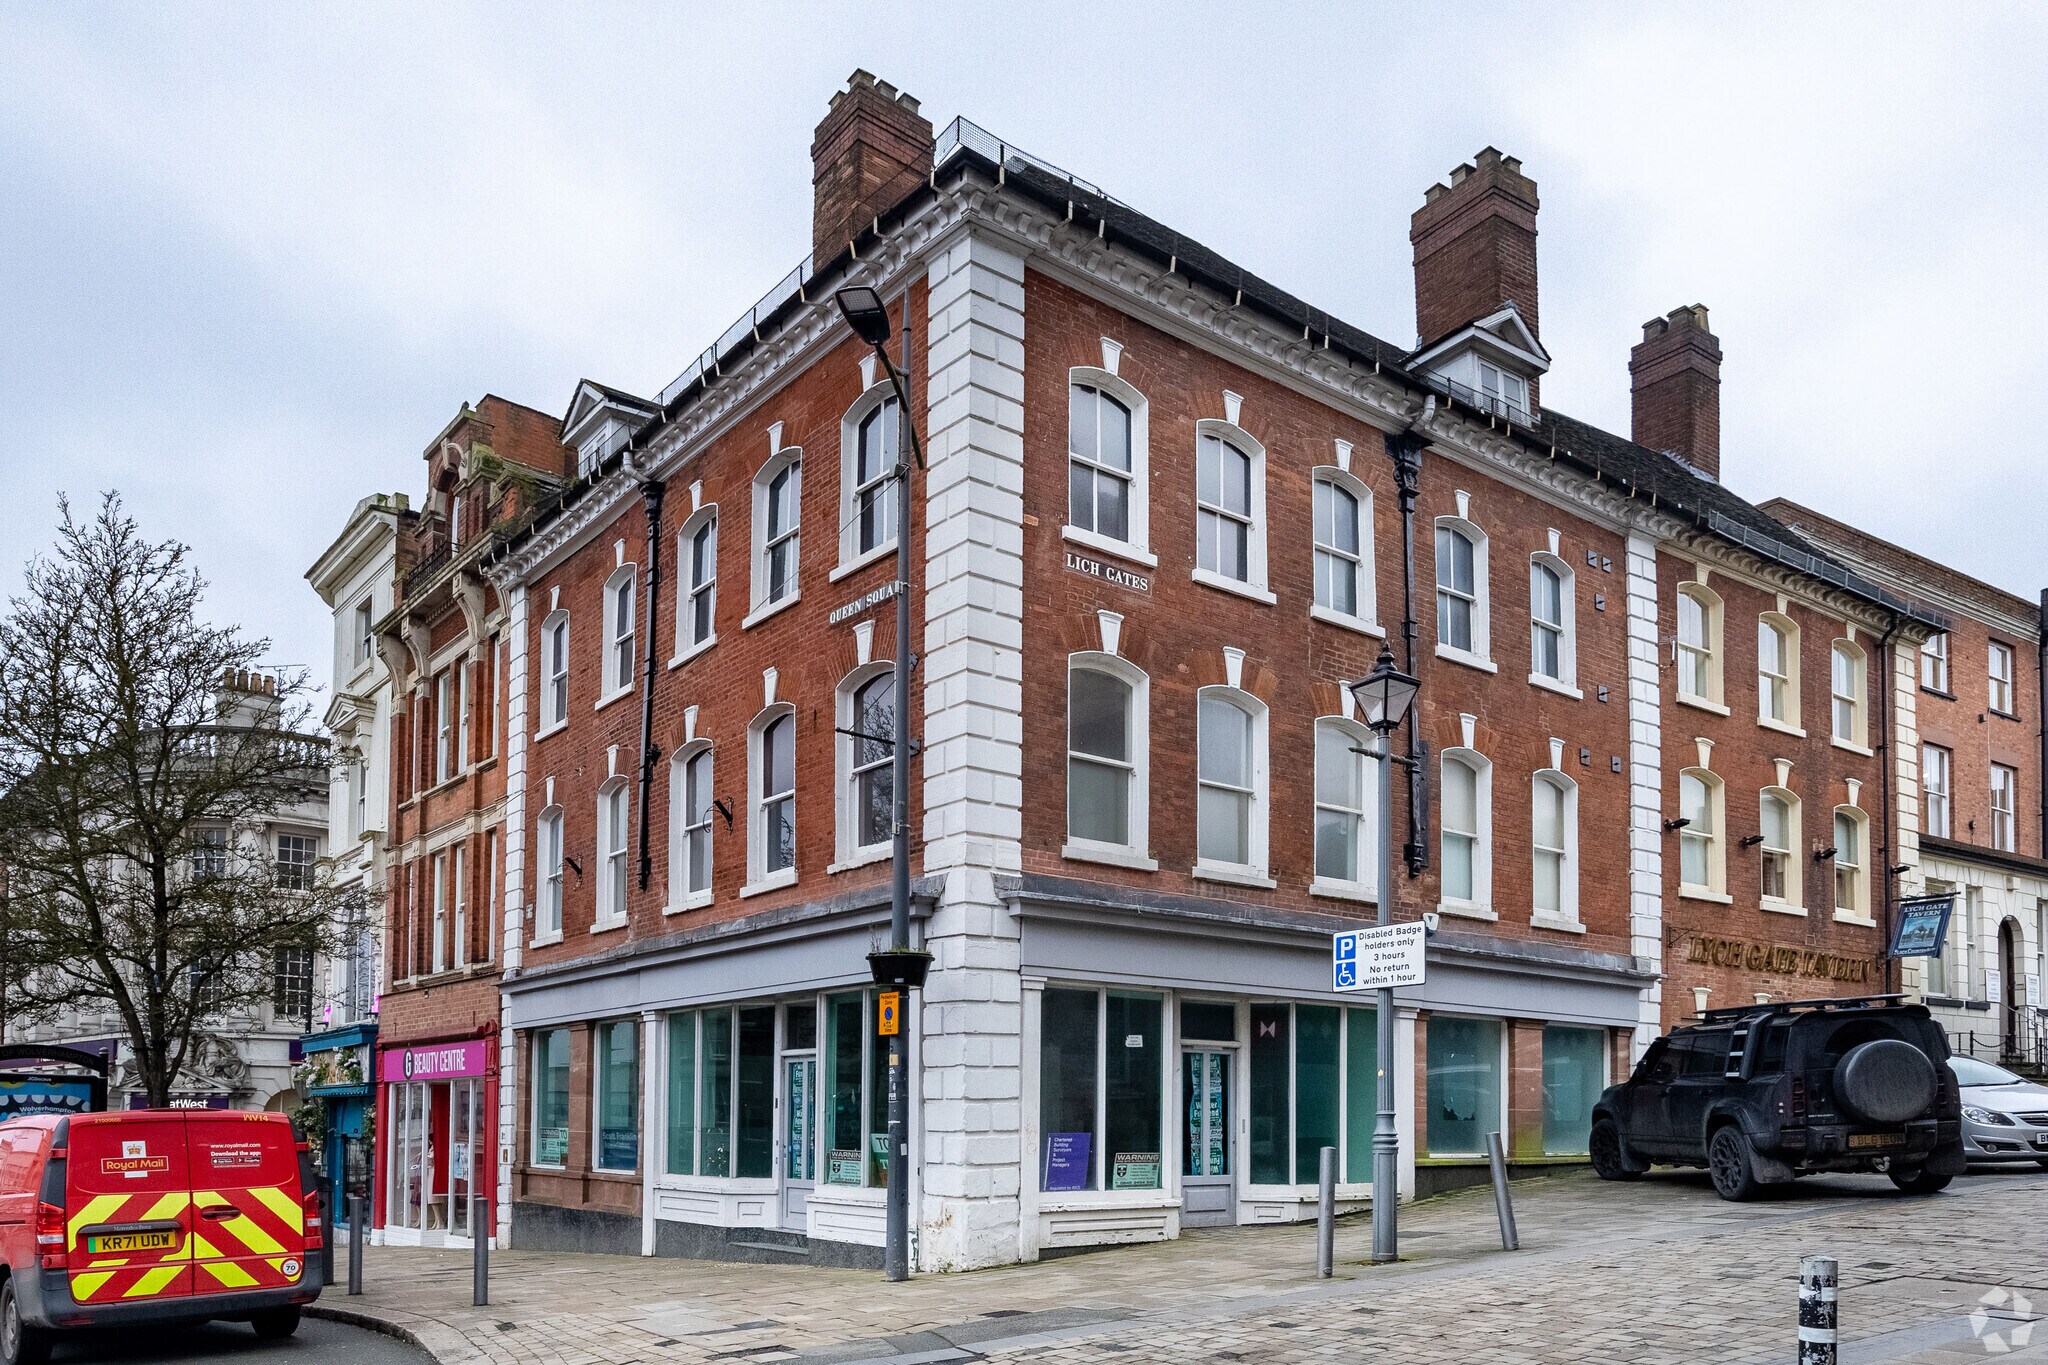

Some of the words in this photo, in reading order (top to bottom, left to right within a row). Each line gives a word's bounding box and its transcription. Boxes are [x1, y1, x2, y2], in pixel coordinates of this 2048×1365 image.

[1066, 553, 1100, 576] LICH
[1106, 567, 1148, 591] GATES
[830, 599, 862, 624] QUEEN
[866, 584, 894, 607] SQUA
[1358, 929, 1392, 940] Disabled
[1396, 926, 1422, 936] Badge
[1340, 938, 1354, 958] P
[1364, 940, 1394, 950] holders
[1396, 938, 1415, 946] only
[1382, 952, 1406, 960] hours
[1688, 935, 1743, 967] LYCH
[1746, 943, 1799, 974] GATE
[1801, 951, 1870, 982] TAVERN
[1384, 964, 1410, 972] return
[1363, 975, 1388, 984] within
[1397, 974, 1416, 982] hour
[18, 1048, 94, 1065] WOLVERHAMPTON
[414, 1050, 439, 1074] BEAUTY
[440, 1049, 466, 1072] CENTRE
[20, 1105, 76, 1114] Wolverhampton
[106, 1161, 138, 1170] Royal
[140, 1159, 164, 1168] Mail
[102, 1236, 137, 1250] KR71
[141, 1234, 169, 1247] UDW
